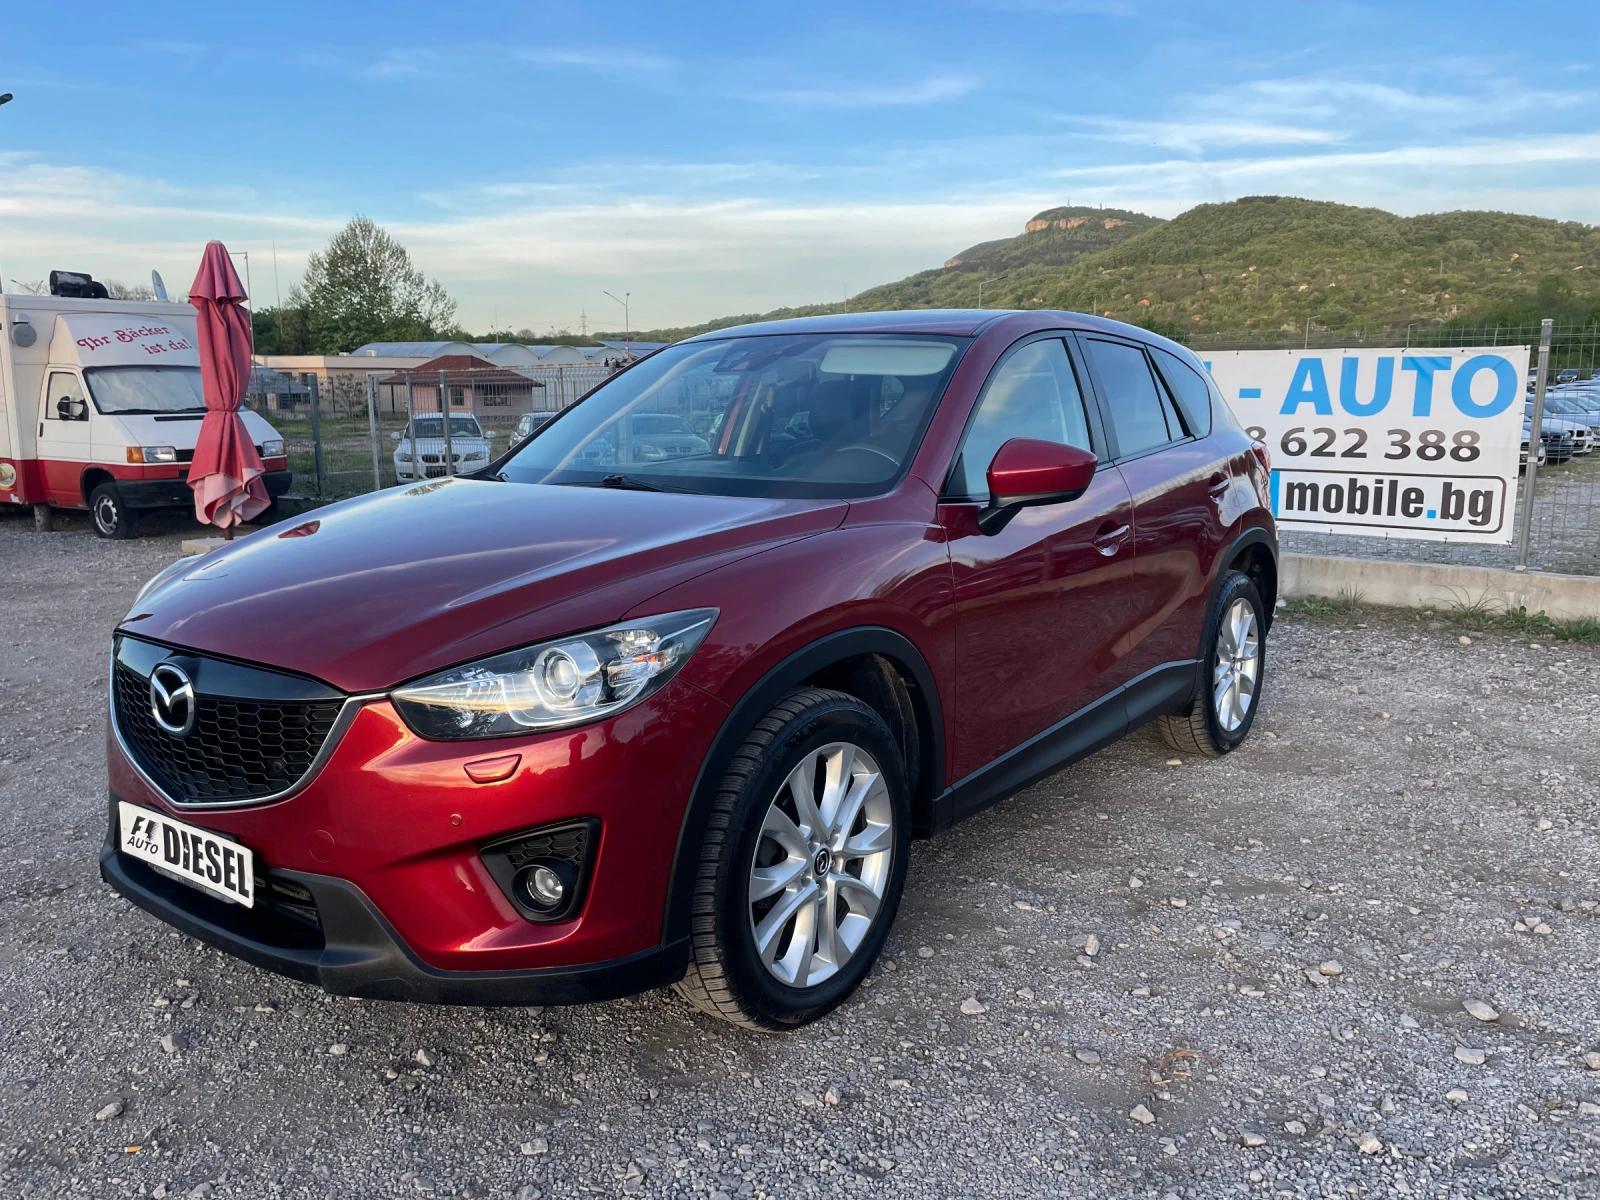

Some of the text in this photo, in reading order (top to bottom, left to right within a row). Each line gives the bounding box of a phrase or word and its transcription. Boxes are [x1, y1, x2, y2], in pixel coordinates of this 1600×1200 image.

[76, 325, 170, 351] Ihr Bäcker
[141, 338, 193, 355] ist da!
[1279, 354, 1518, 418] AUTO
[1280, 426, 1368, 458] 622
[1384, 429, 1481, 462] 388
[1285, 477, 1494, 526] mobile.bg
[127, 836, 159, 854] AUTO
[162, 822, 250, 899] DIESEL
